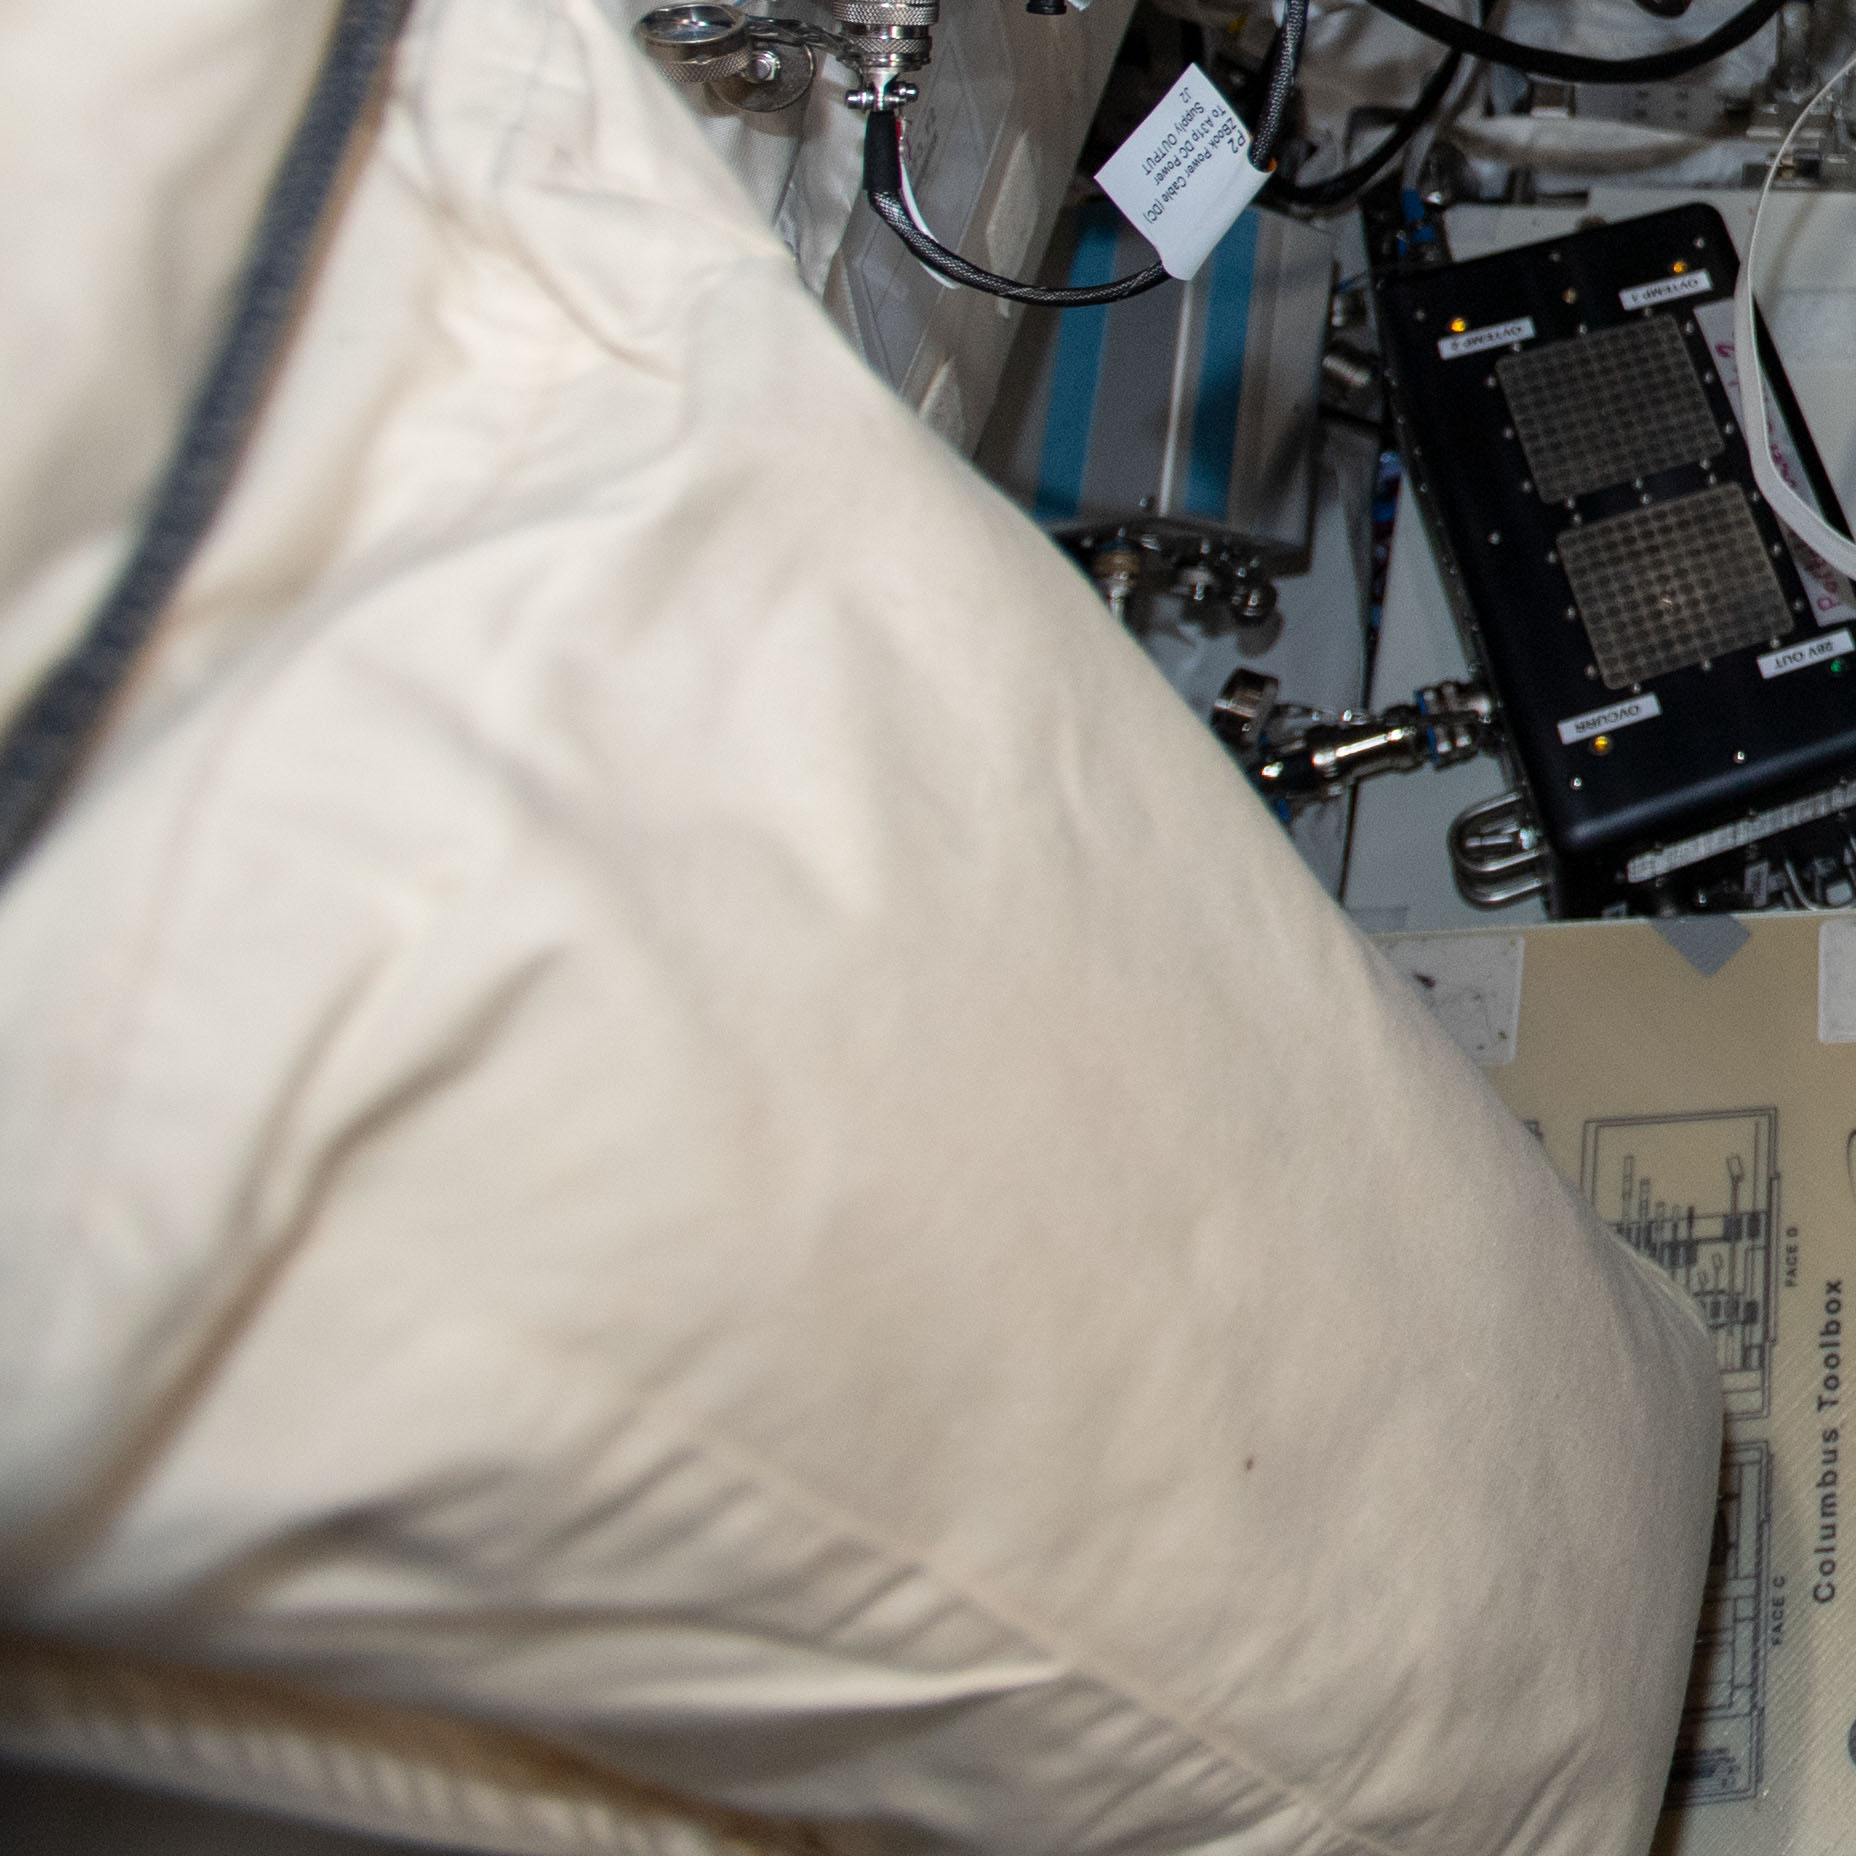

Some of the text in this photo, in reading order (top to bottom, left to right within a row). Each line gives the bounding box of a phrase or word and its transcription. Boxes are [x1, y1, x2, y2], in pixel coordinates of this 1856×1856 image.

[1177, 86, 1194, 104] J2
[1139, 100, 1206, 175] Supply OUTPUT
[1152, 103, 1226, 186] To A31p DC Power
[1207, 117, 1237, 152] ZBook
[1226, 130, 1247, 153] P2
[1184, 145, 1212, 177] Power
[1158, 172, 1187, 205] Cable
[1770, 648, 1805, 670] OUT
[1811, 1276, 1844, 1605] Columbus Toolbox
